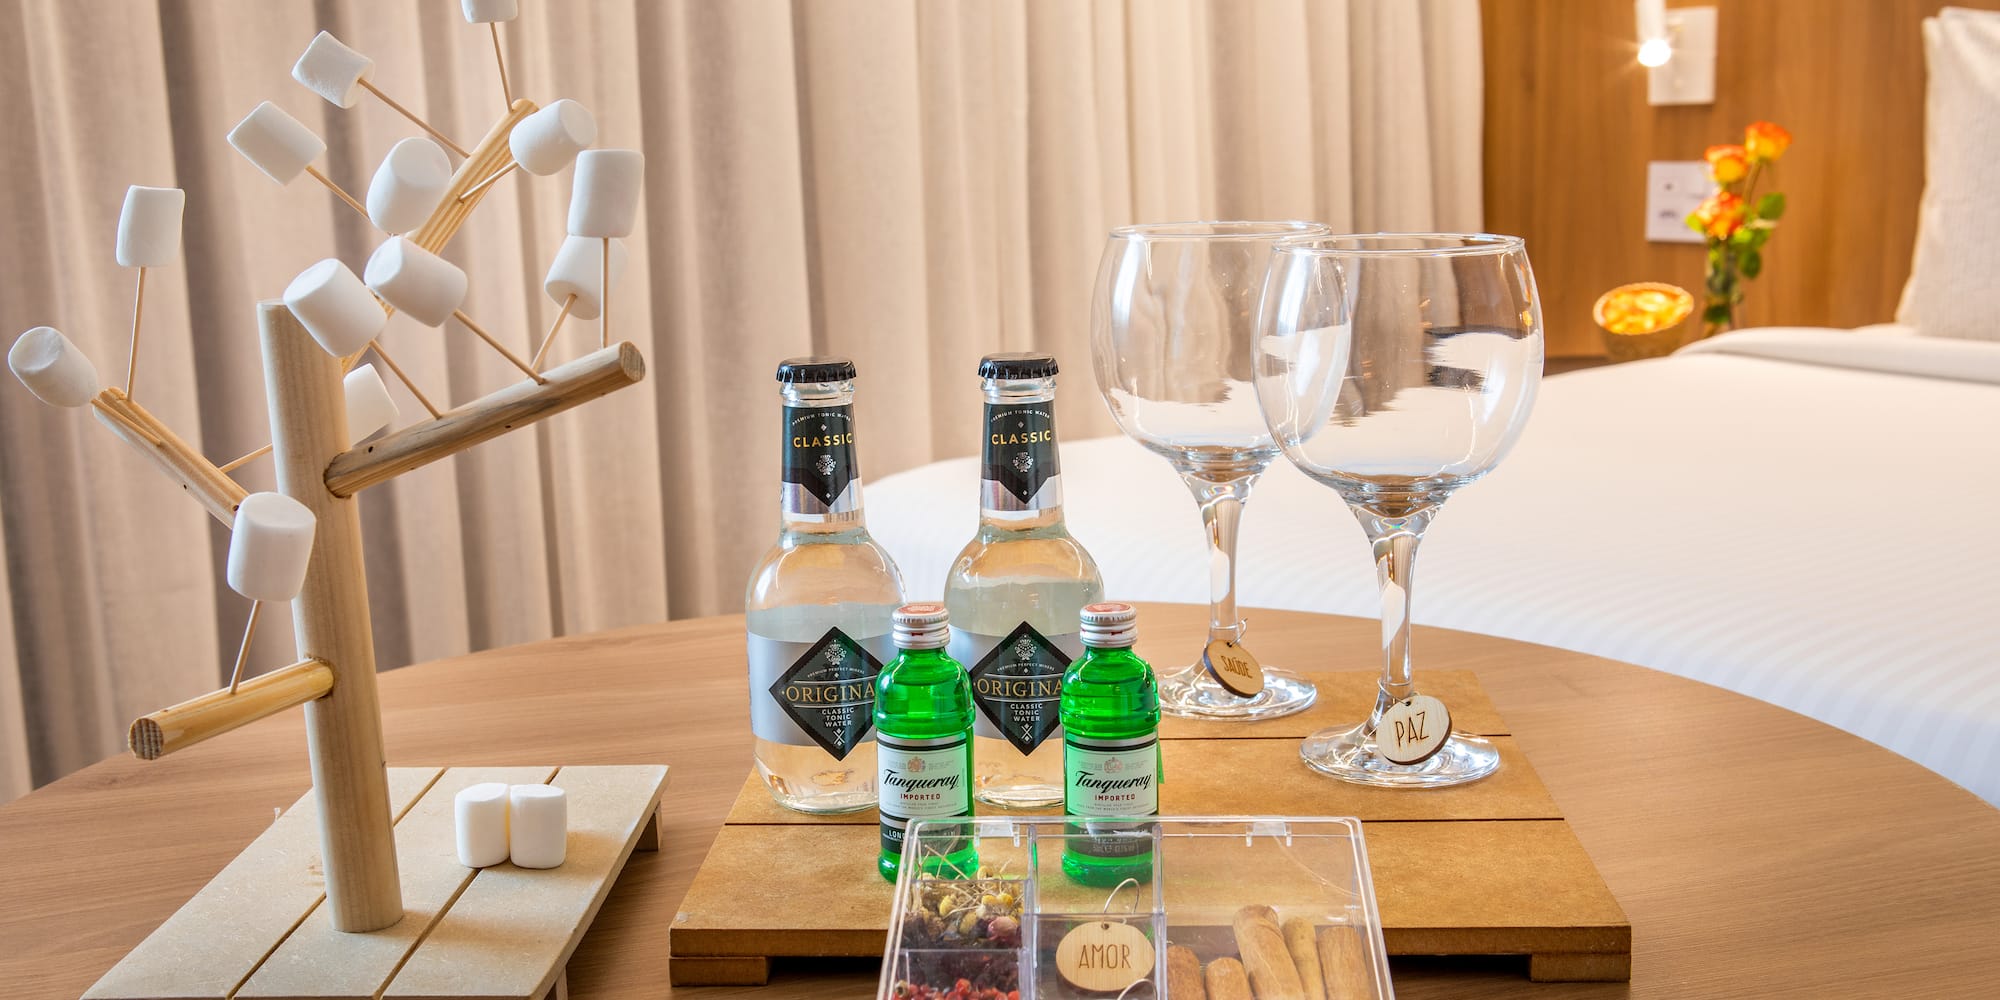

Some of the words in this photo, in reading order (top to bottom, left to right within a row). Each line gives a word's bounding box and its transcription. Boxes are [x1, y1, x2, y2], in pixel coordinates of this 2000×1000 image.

[990, 410, 1013, 423] PREMIUM
[1035, 410, 1050, 419] WATER
[793, 432, 853, 448] CLASSIC
[991, 430, 1052, 445] CLASSIC
[785, 682, 875, 703] ORIGINA
[977, 678, 1062, 698] ORIGINA
[821, 707, 855, 716] CLASSIC
[825, 713, 851, 721] TONIC
[824, 720, 852, 728] WATER
[1395, 710, 1430, 748] PAZ
[884, 768, 960, 793] Tanqueray
[1075, 770, 1152, 794] Tanqueray
[900, 793, 941, 801] IMPORTED
[1094, 793, 1136, 801] IMPORTED
[1078, 943, 1132, 969] AMOR
